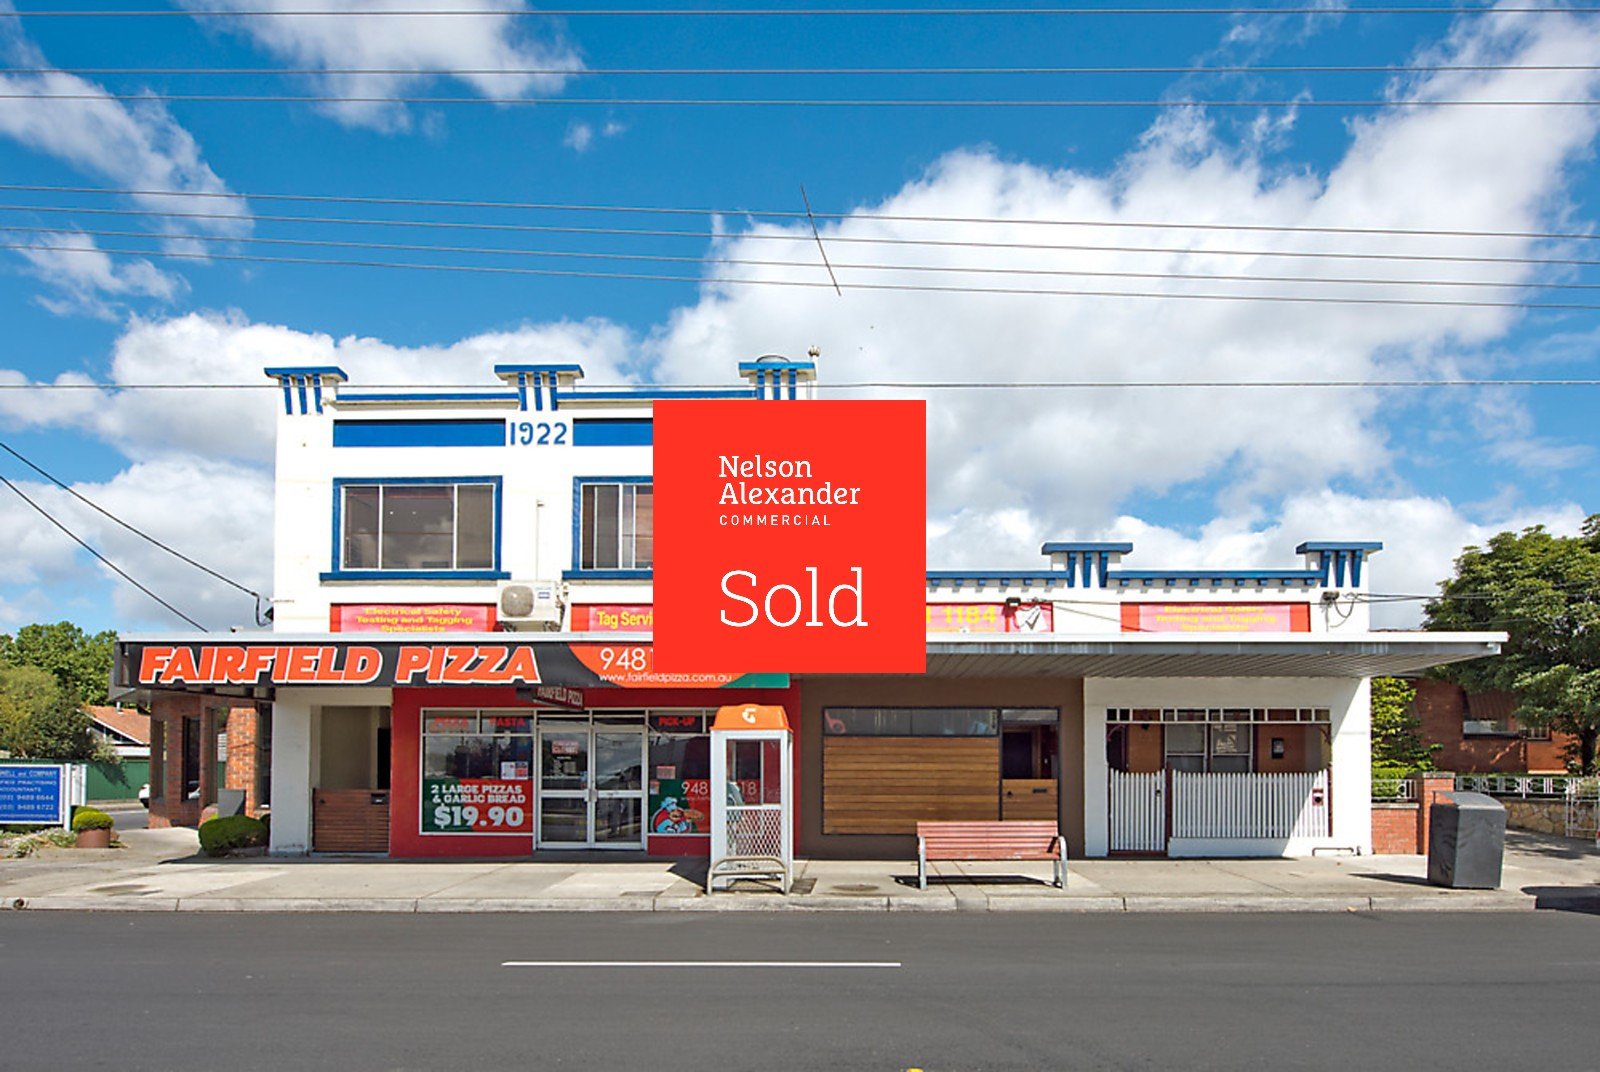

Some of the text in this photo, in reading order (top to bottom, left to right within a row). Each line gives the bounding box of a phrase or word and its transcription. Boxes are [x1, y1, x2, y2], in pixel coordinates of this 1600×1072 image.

[510, 422, 567, 446] 1922
[364, 608, 461, 617] Electrical Safety
[597, 610, 653, 629] Tag Servi
[138, 646, 541, 685] FAIRFIELD PIZZA
[600, 672, 732, 683] www.fairfieldpizza.com.au
[431, 785, 522, 794] 2 LARGE PIZZAS
[433, 795, 526, 804] & GARLIC BREAD
[434, 803, 524, 829] $19.90
